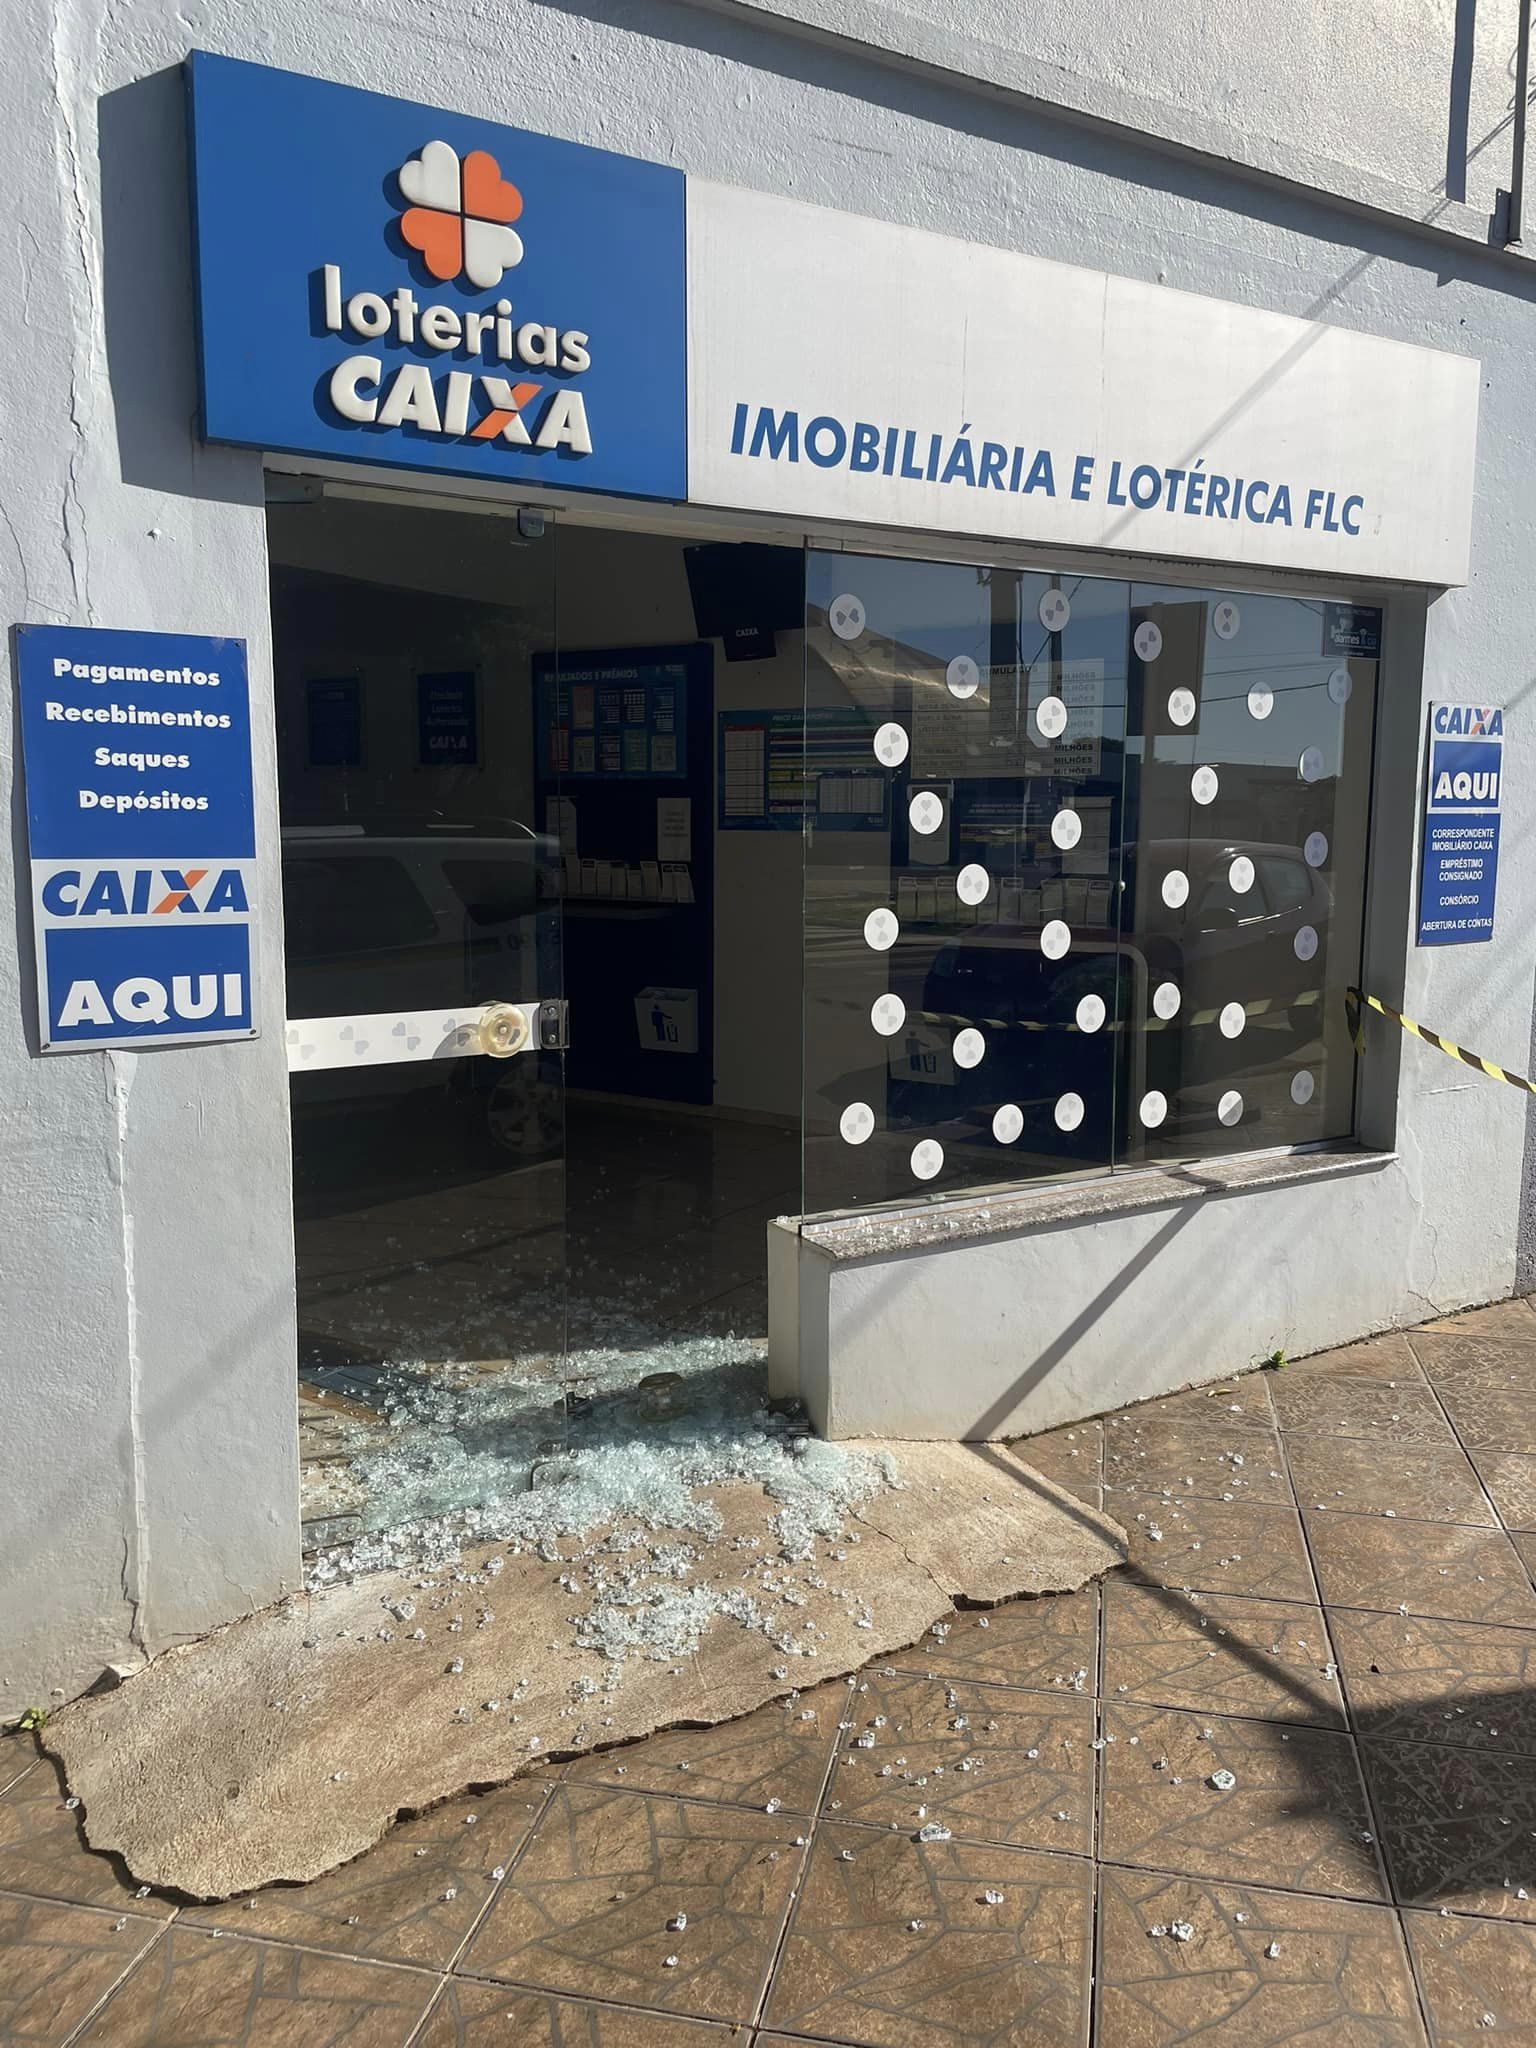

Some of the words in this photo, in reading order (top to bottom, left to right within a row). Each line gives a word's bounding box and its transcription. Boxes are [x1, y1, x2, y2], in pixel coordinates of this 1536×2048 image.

[324, 263, 591, 373] loterias
[330, 355, 593, 454] CAIXA
[730, 402, 1056, 497] IMOBILIÁRIA
[1070, 455, 1095, 501] E
[1107, 458, 1293, 527] LOTÉRICA
[1304, 489, 1364, 536] FLC
[53, 658, 221, 686] Pagamentos
[45, 702, 232, 729] Recebimentos
[1434, 706, 1504, 736] CAIXA
[94, 747, 190, 771] Saques
[1434, 771, 1498, 801] AQUI
[79, 790, 209, 813] Depósitos
[1431, 840, 1473, 851] IMOBILIÁRIO
[1473, 841, 1493, 850] CAIXA
[1432, 828, 1495, 839] CORRESPONDENTE
[1439, 870, 1483, 881] CONSIGNADO
[1440, 857, 1484, 869] EMPRÉSTIMO
[41, 868, 250, 917] CAIXA
[1439, 893, 1479, 906] CONSÓRCIO
[1421, 920, 1457, 931] ABERTURA
[1457, 919, 1467, 929] DE
[1467, 918, 1493, 928] CONTAS
[57, 973, 244, 1027] AQUI
